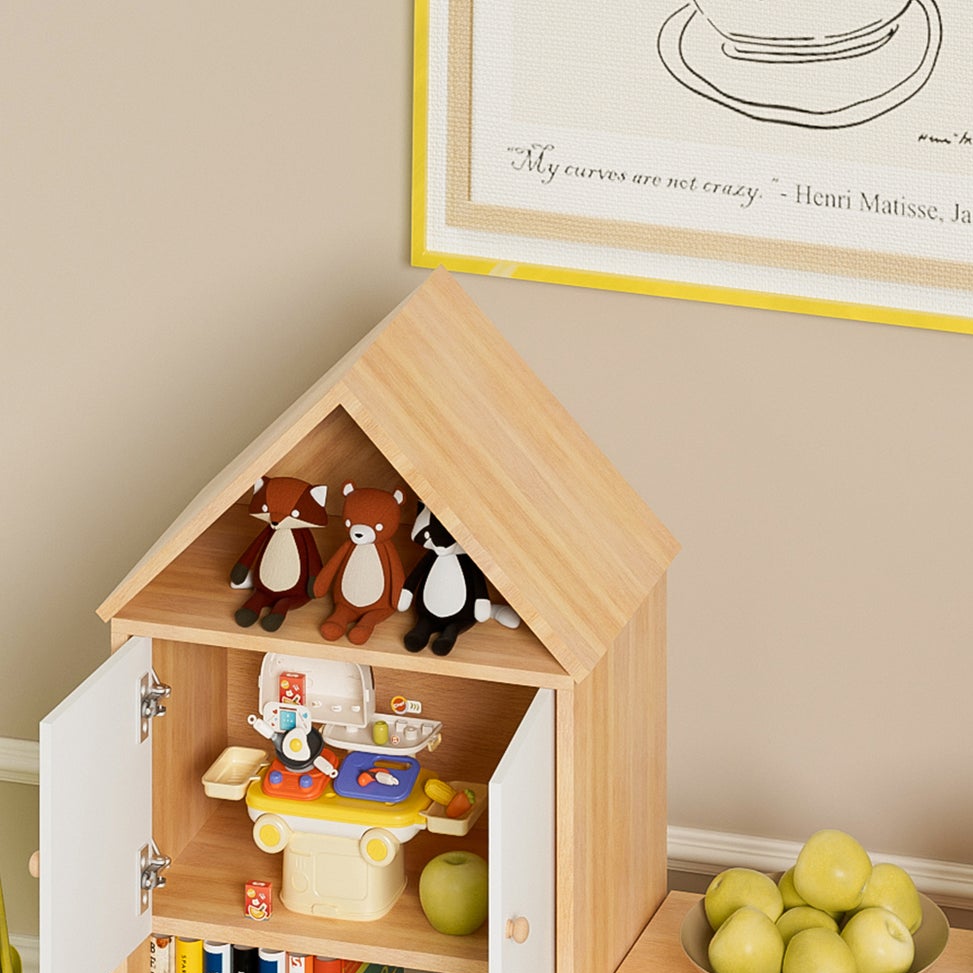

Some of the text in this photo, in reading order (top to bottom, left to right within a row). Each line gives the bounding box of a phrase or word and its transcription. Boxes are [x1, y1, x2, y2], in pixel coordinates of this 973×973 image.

[564, 164, 626, 182] curves
[632, 174, 662, 188] are
[667, 176, 697, 191] not
[796, 183, 852, 210] Henri
[860, 192, 944, 223] Matisse,
